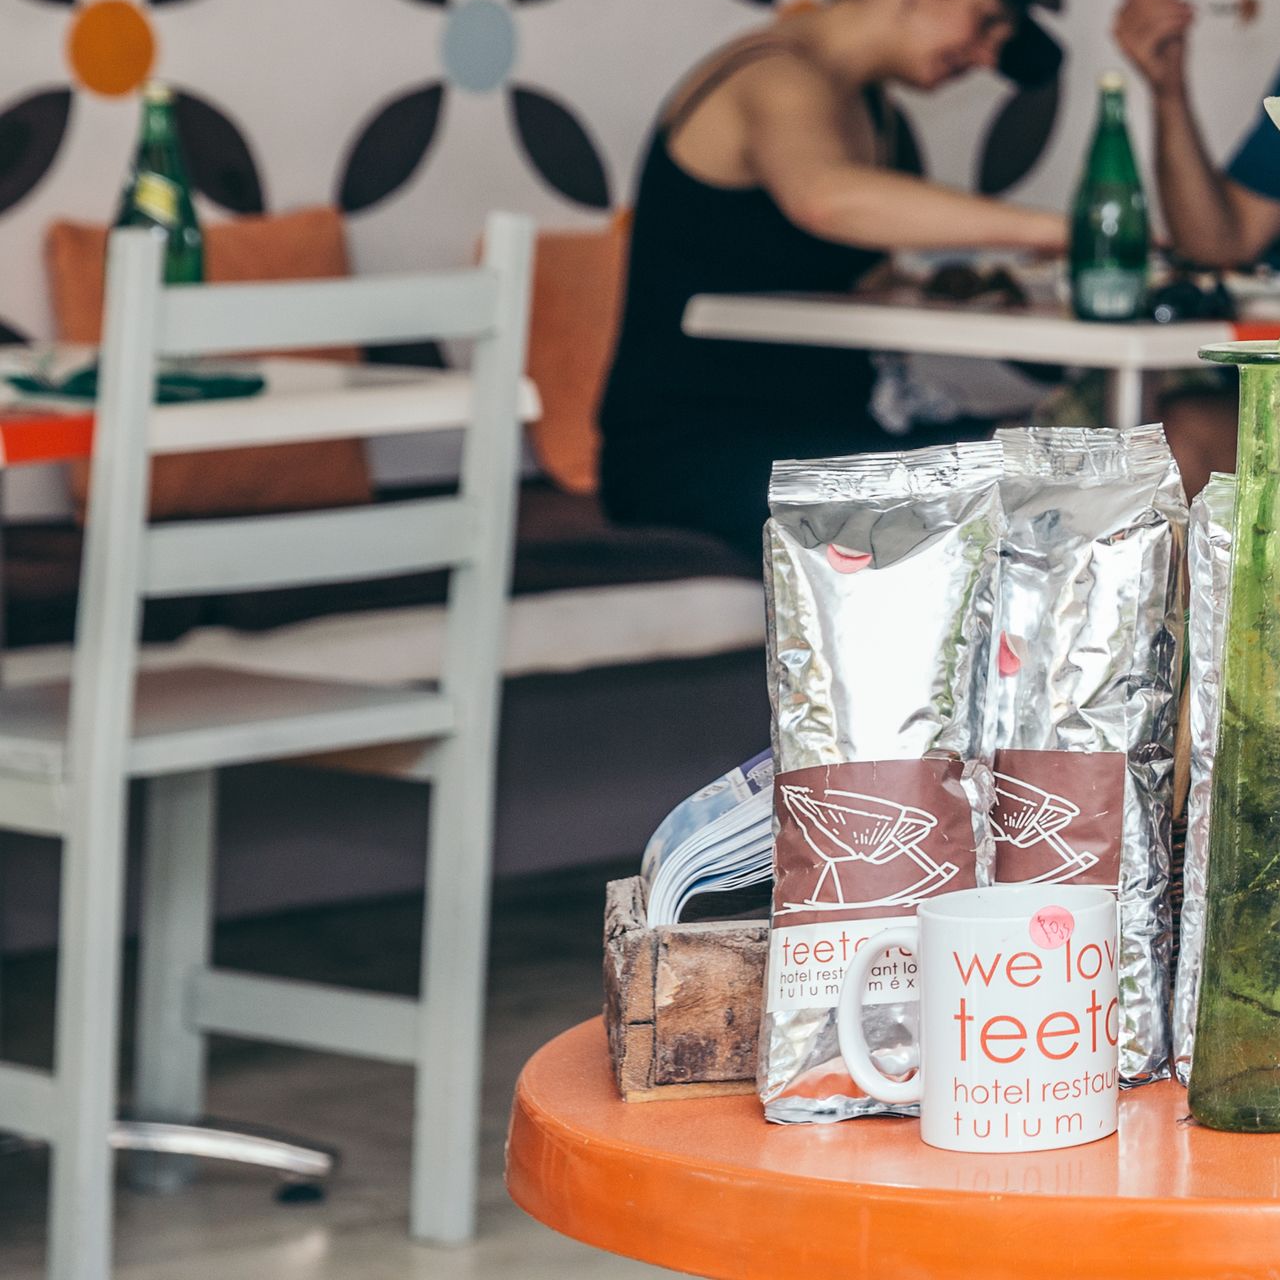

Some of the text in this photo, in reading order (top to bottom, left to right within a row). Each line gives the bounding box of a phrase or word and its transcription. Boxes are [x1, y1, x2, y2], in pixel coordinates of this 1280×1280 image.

[780, 970, 812, 984] hotel
[816, 961, 898, 980] restant
[952, 951, 1043, 988] we
[780, 983, 839, 999] tulum
[953, 1076, 1031, 1105] hotel
